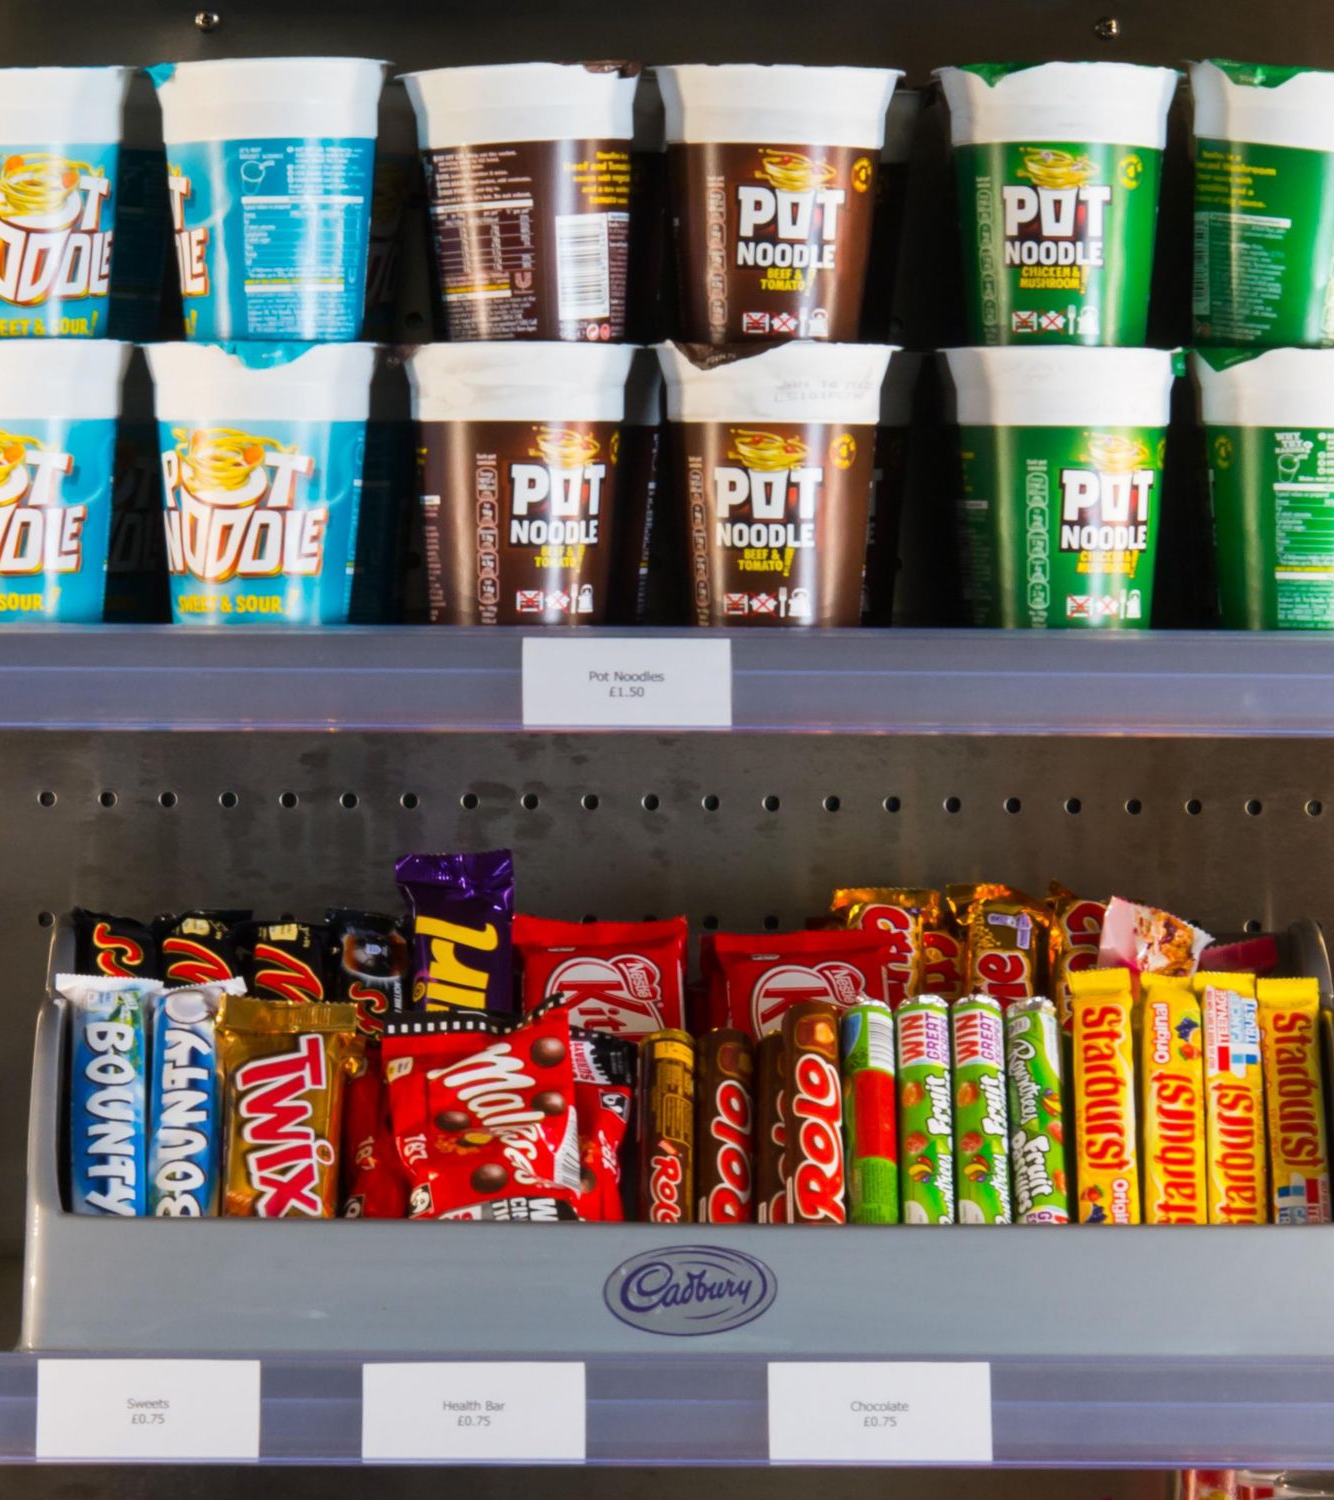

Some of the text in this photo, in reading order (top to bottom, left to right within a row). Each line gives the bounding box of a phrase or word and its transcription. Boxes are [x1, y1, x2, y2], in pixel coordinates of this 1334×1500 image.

[736, 185, 845, 239] POT
[1003, 185, 1111, 237] POT
[738, 241, 836, 268] NOODLE
[1005, 241, 1103, 266] NOODLE
[767, 268, 791, 280] BEEF
[1022, 266, 1069, 278] CHICKEN
[511, 463, 605, 517] POT
[715, 466, 823, 519] POT
[1062, 469, 1153, 522] POT
[510, 520, 598, 545] NOODLE
[716, 523, 815, 548] NOODLE
[1061, 525, 1147, 550] NOODLE
[744, 548, 766, 560] BEEF
[589, 671, 666, 683] Pot Noodles
[609, 687, 646, 698] £1.50
[901, 1013, 924, 1063] WIN
[925, 1013, 939, 1060] GREAT
[956, 1013, 979, 1064] WIN
[980, 1012, 995, 1061] GREAT
[1153, 1003, 1171, 1063] Original
[1081, 1004, 1133, 1171] Starburst
[1272, 1010, 1324, 1168] Starburst
[85, 1022, 137, 1216] BOUNTY
[793, 1053, 845, 1223] Rolo
[621, 1262, 753, 1313] Cadbury
[126, 1398, 171, 1410] Sweets
[443, 1399, 505, 1412] Health Bar
[850, 1400, 910, 1412] Chocolate
[131, 1414, 166, 1425] £0.75
[457, 1416, 492, 1427] £0.75
[864, 1416, 898, 1428] £0.75
